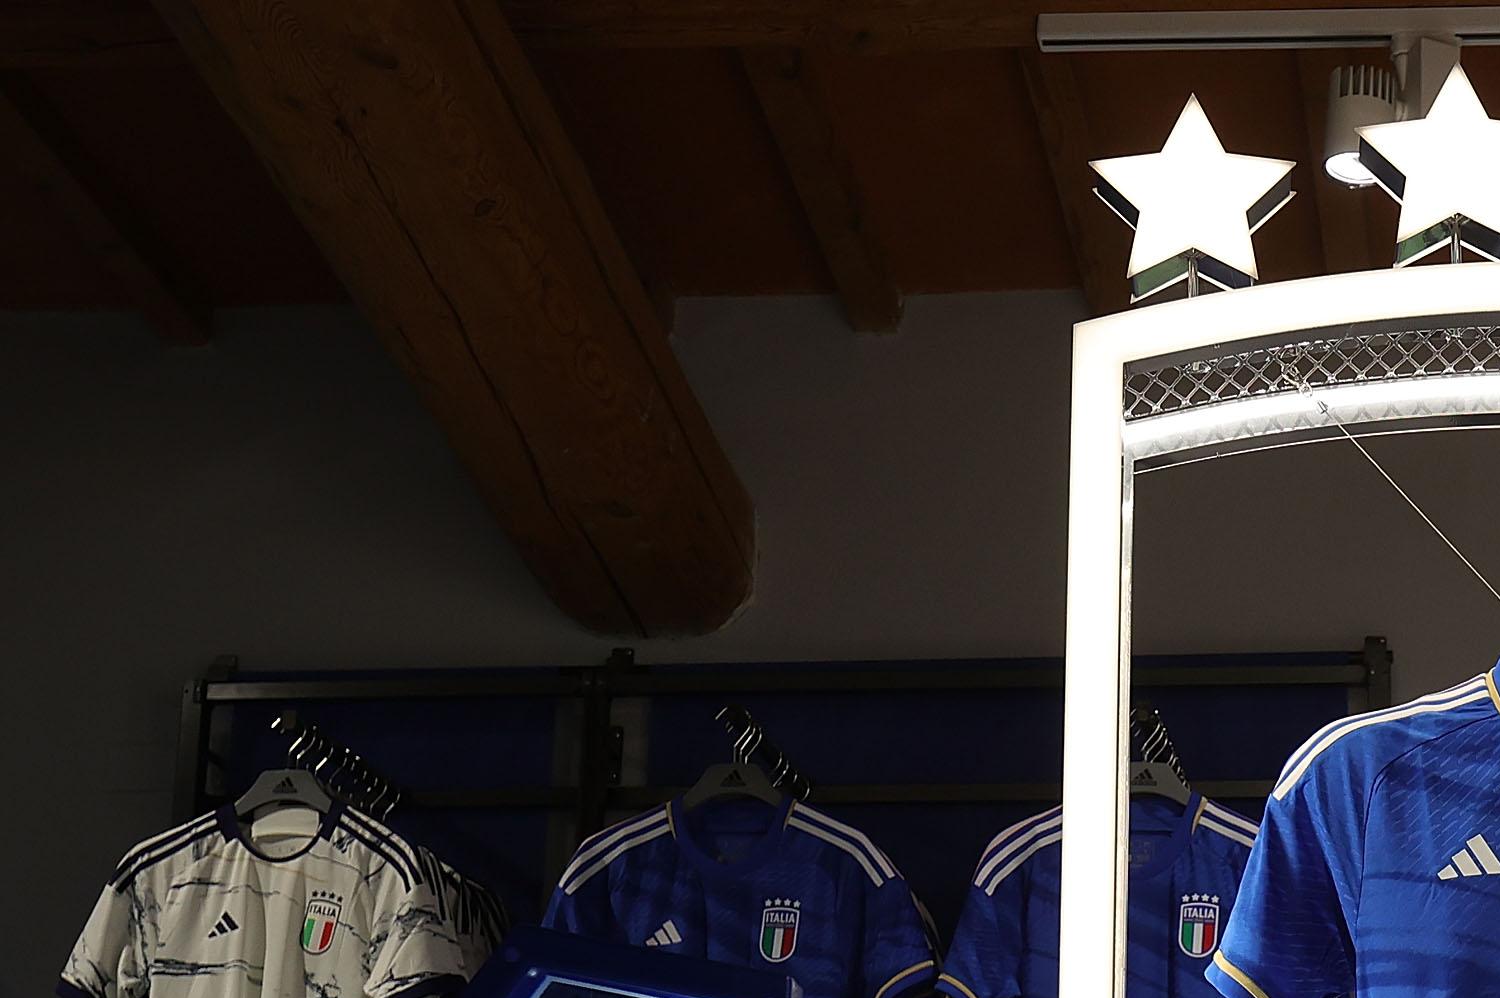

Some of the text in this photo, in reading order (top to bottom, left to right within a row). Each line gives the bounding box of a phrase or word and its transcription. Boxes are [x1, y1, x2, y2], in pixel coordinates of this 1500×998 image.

[309, 904, 336, 918] ITALIA
[1183, 907, 1215, 919] ITALIA
[765, 912, 796, 924] ITALIA
